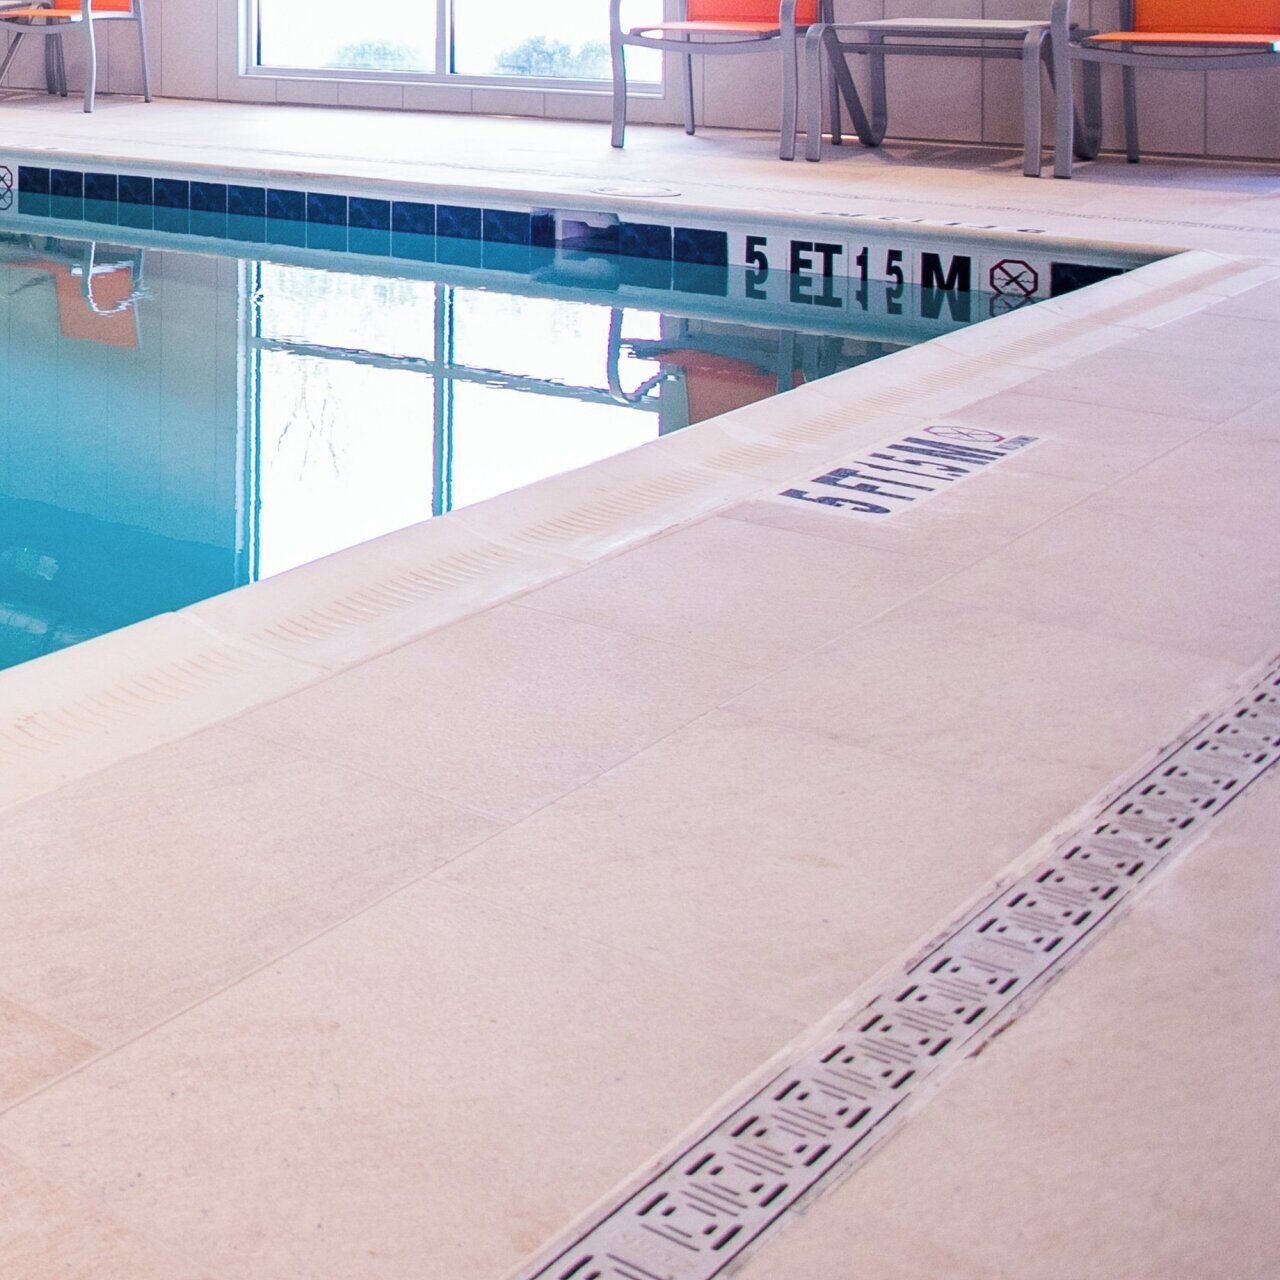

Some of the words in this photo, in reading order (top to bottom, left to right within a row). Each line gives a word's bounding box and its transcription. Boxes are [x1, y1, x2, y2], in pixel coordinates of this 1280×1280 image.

[885, 436, 1008, 466] M
[811, 467, 936, 502] FT
[778, 488, 891, 515] 5
